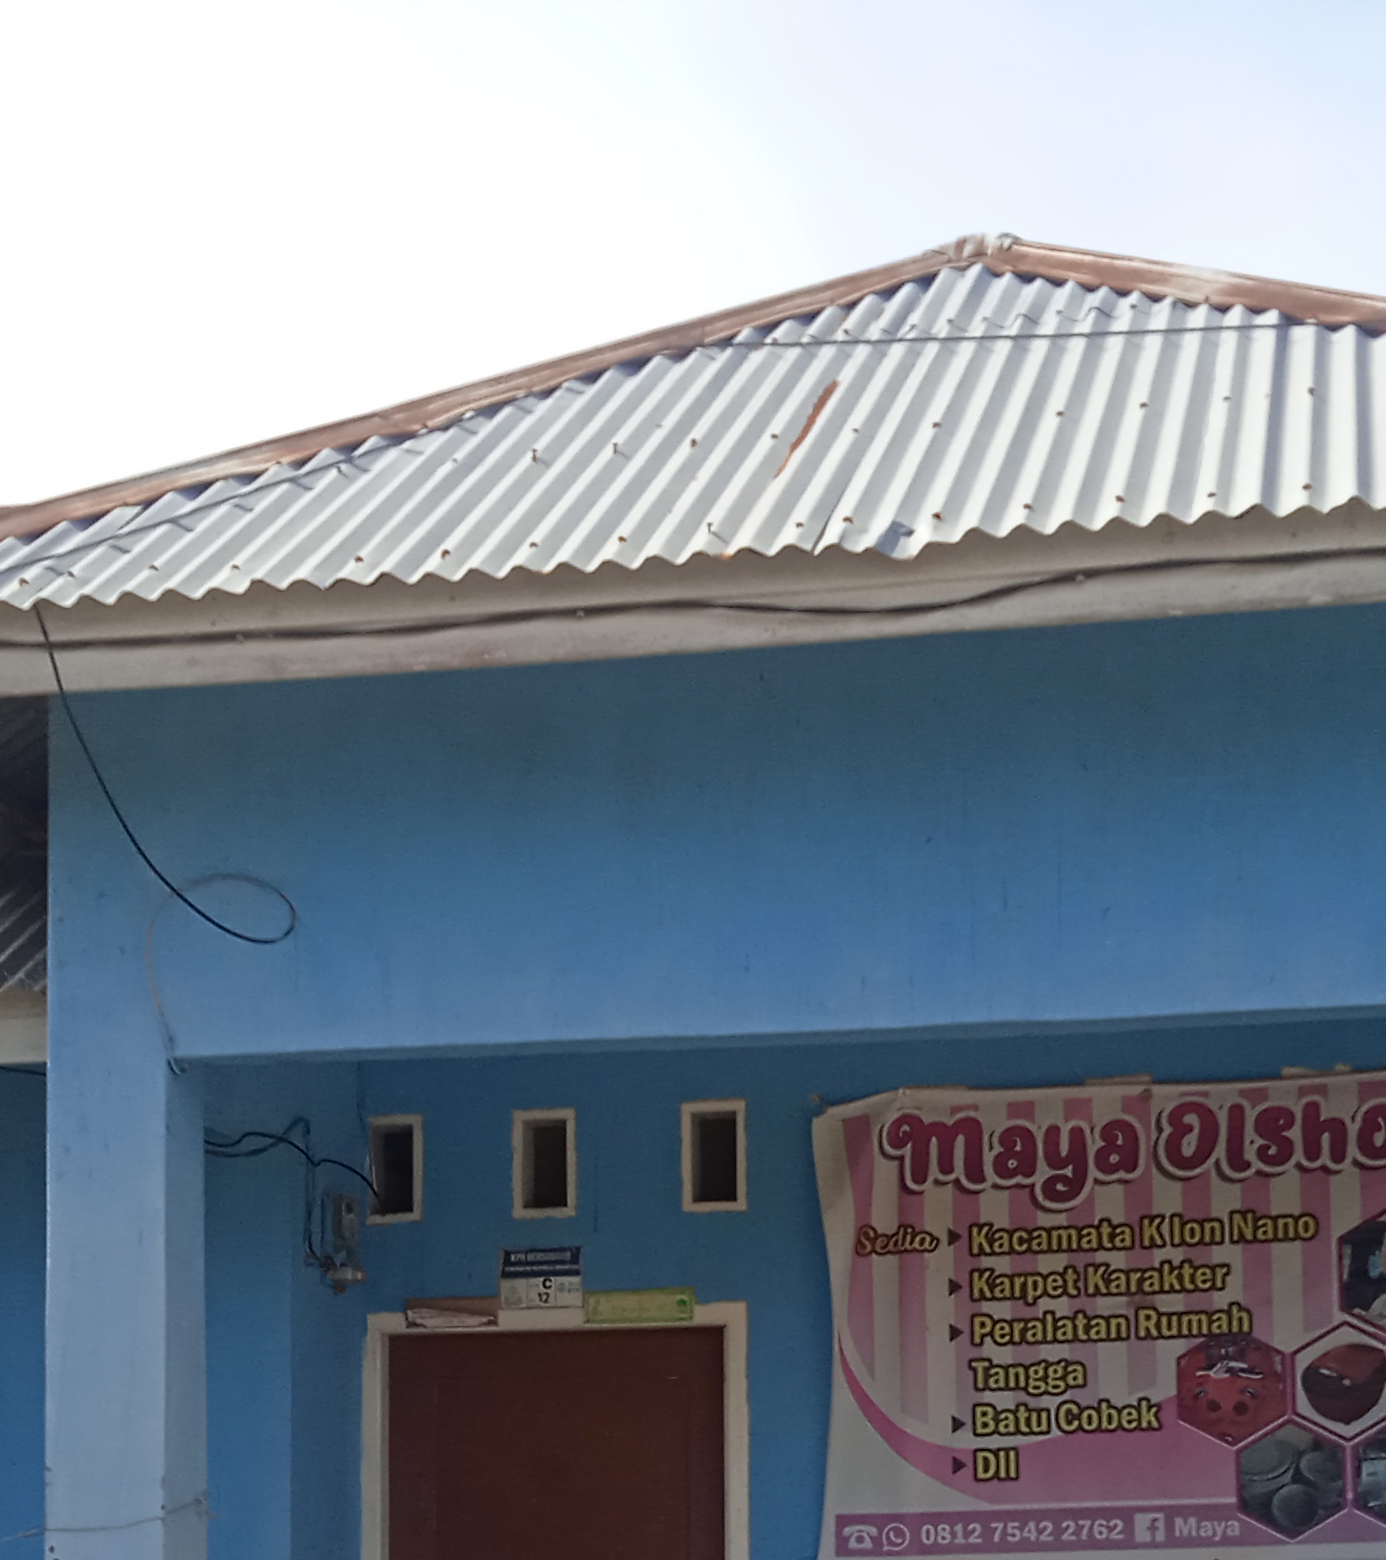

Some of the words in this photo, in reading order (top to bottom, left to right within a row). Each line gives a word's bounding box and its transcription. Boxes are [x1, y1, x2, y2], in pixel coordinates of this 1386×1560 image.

[883, 1111, 1145, 1207] Maya
[857, 1224, 939, 1256] Sedia
[970, 1219, 1133, 1254] Kacamata
[1141, 1215, 1168, 1247] K
[1171, 1213, 1222, 1245] Ion
[1229, 1211, 1318, 1243] Nano
[541, 1277, 553, 1290] C
[970, 1267, 1079, 1303] Karpet
[1086, 1261, 1230, 1296] Karakter
[971, 1312, 1129, 1345] Peralatan
[1135, 1303, 1253, 1338] Rumah
[970, 1360, 1086, 1393] Tangga
[973, 1403, 1050, 1435] Batu
[1056, 1398, 1161, 1432] Cobek
[920, 1523, 983, 1545] 0812
[990, 1520, 1054, 1543] 7542
[1060, 1518, 1125, 1542] 2762
[1173, 1515, 1241, 1541] Maya
